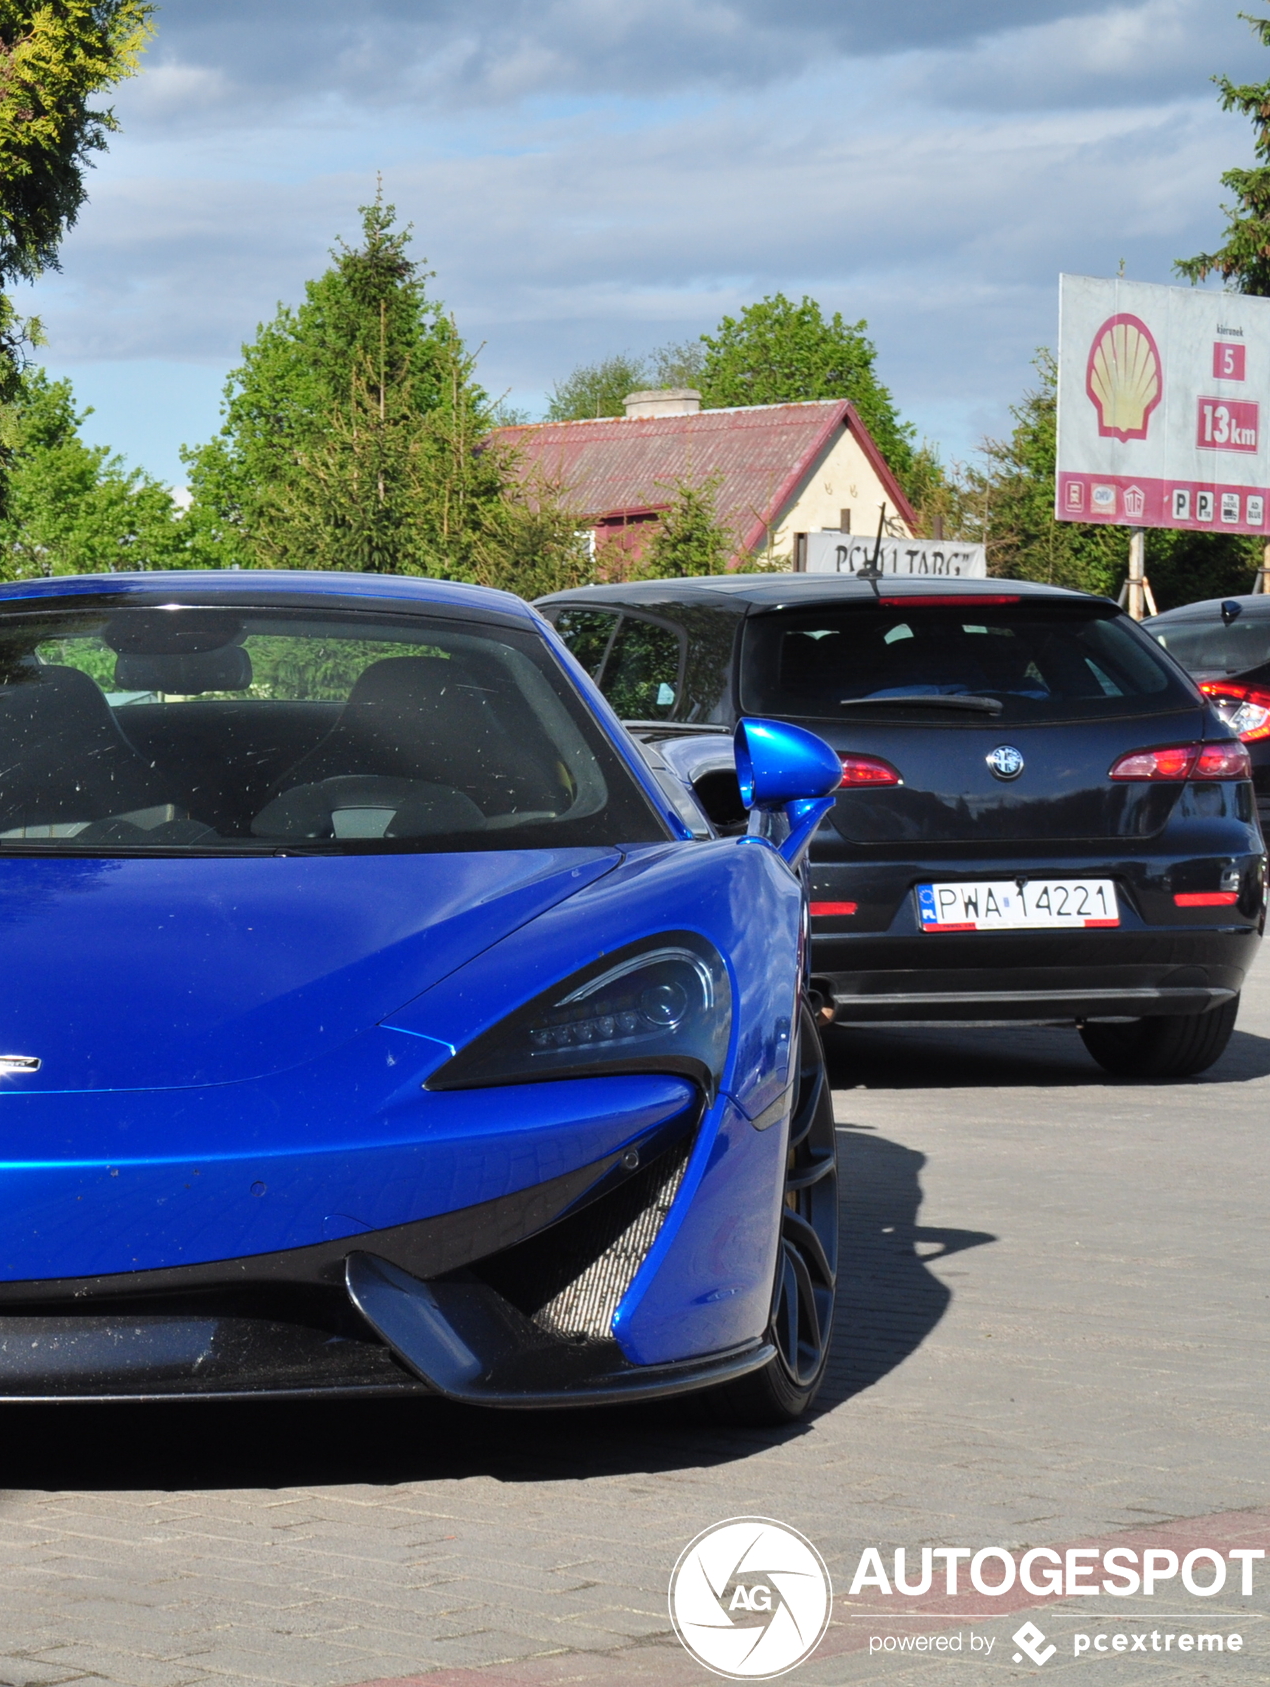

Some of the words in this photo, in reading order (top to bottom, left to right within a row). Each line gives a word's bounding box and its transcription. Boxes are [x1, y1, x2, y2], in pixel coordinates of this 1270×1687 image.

[1216, 323, 1244, 337] kierunek
[1223, 348, 1234, 374] 5
[1176, 493, 1186, 515] P
[1199, 495, 1208, 517] P
[938, 887, 1002, 919] PWA
[1016, 885, 1108, 917] 14221
